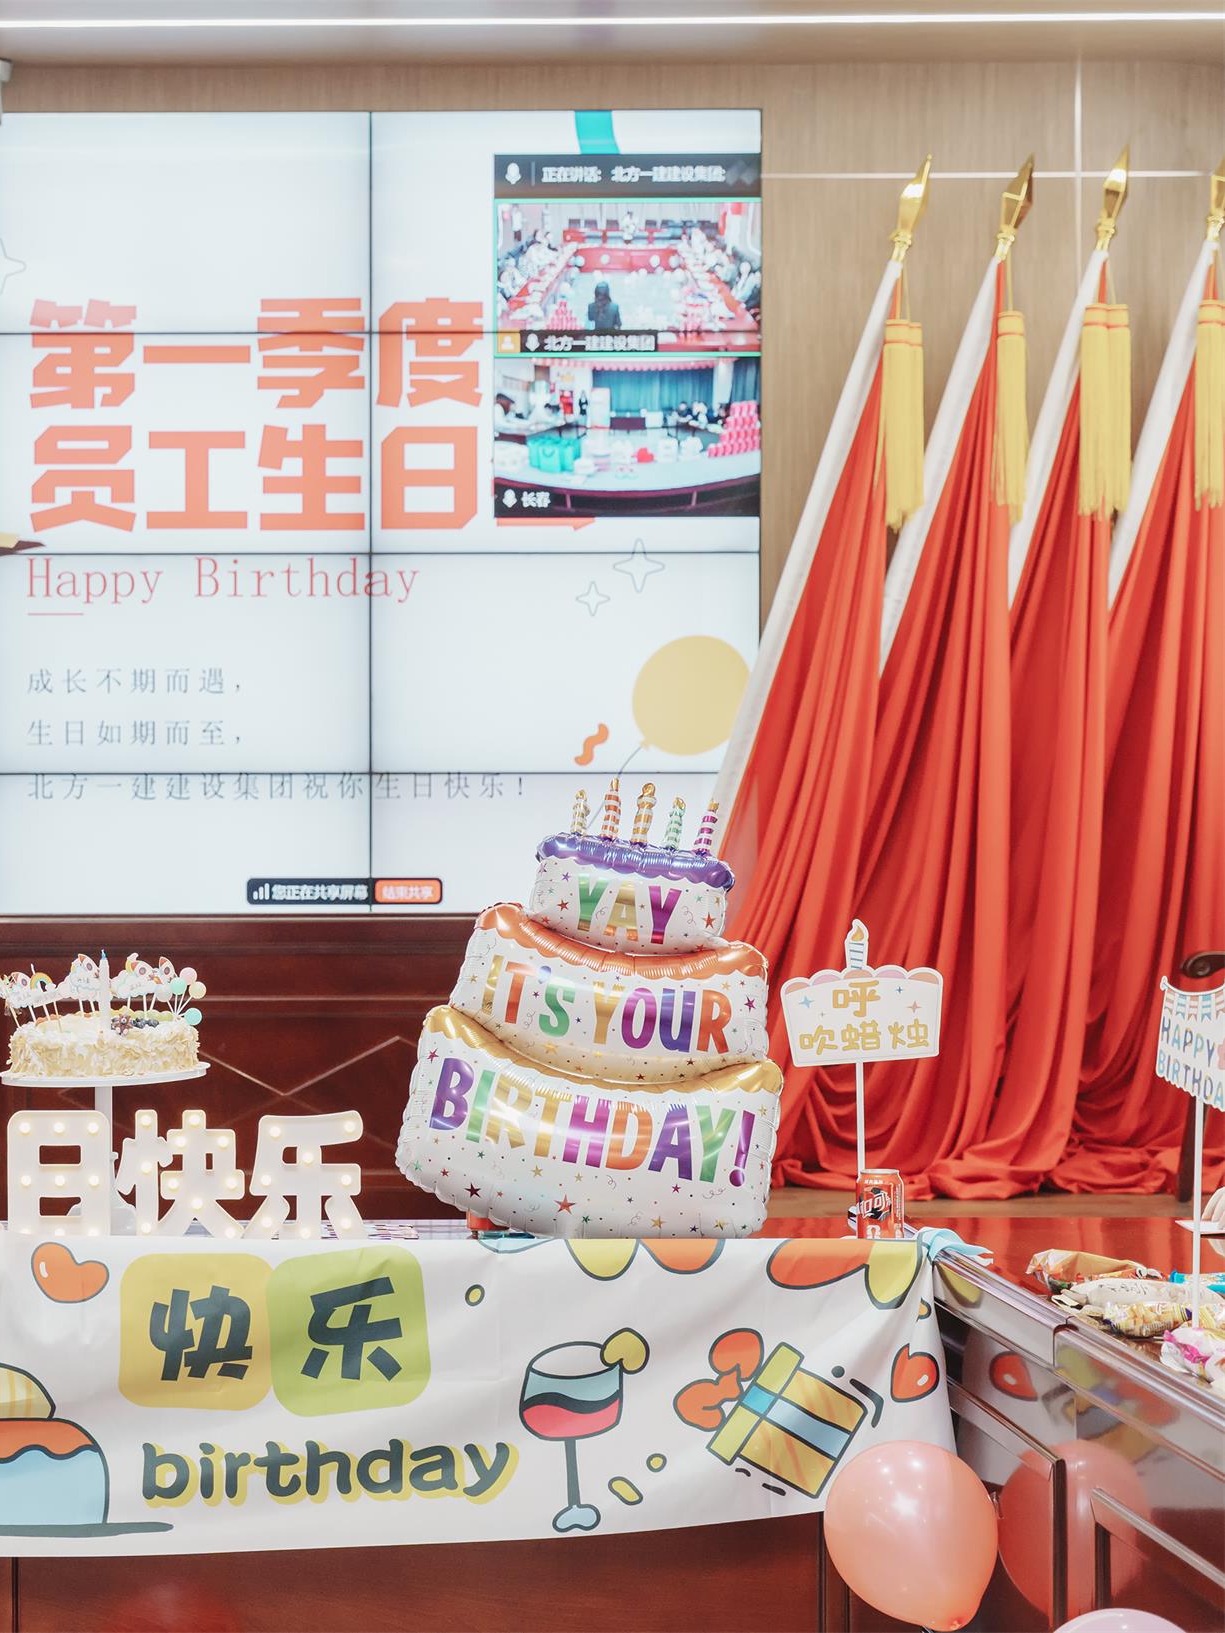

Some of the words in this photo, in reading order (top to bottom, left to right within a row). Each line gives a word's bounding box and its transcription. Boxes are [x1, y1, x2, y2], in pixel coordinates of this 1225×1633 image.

[29, 298, 484, 409] 第一季度
[29, 423, 478, 532] 员工生日
[26, 557, 163, 603] Happy
[194, 556, 420, 603] Birthday
[575, 873, 683, 944] YAY
[478, 954, 575, 1038] IT'S
[591, 980, 732, 1055] YOUR
[832, 979, 881, 1018] 呼
[799, 1018, 930, 1056] 吹蜡烛
[1161, 1016, 1216, 1068] HAPPY
[428, 1057, 756, 1188] BIRTHDAY!
[149, 1276, 403, 1382] 快乐
[141, 1438, 519, 1507] birthday
